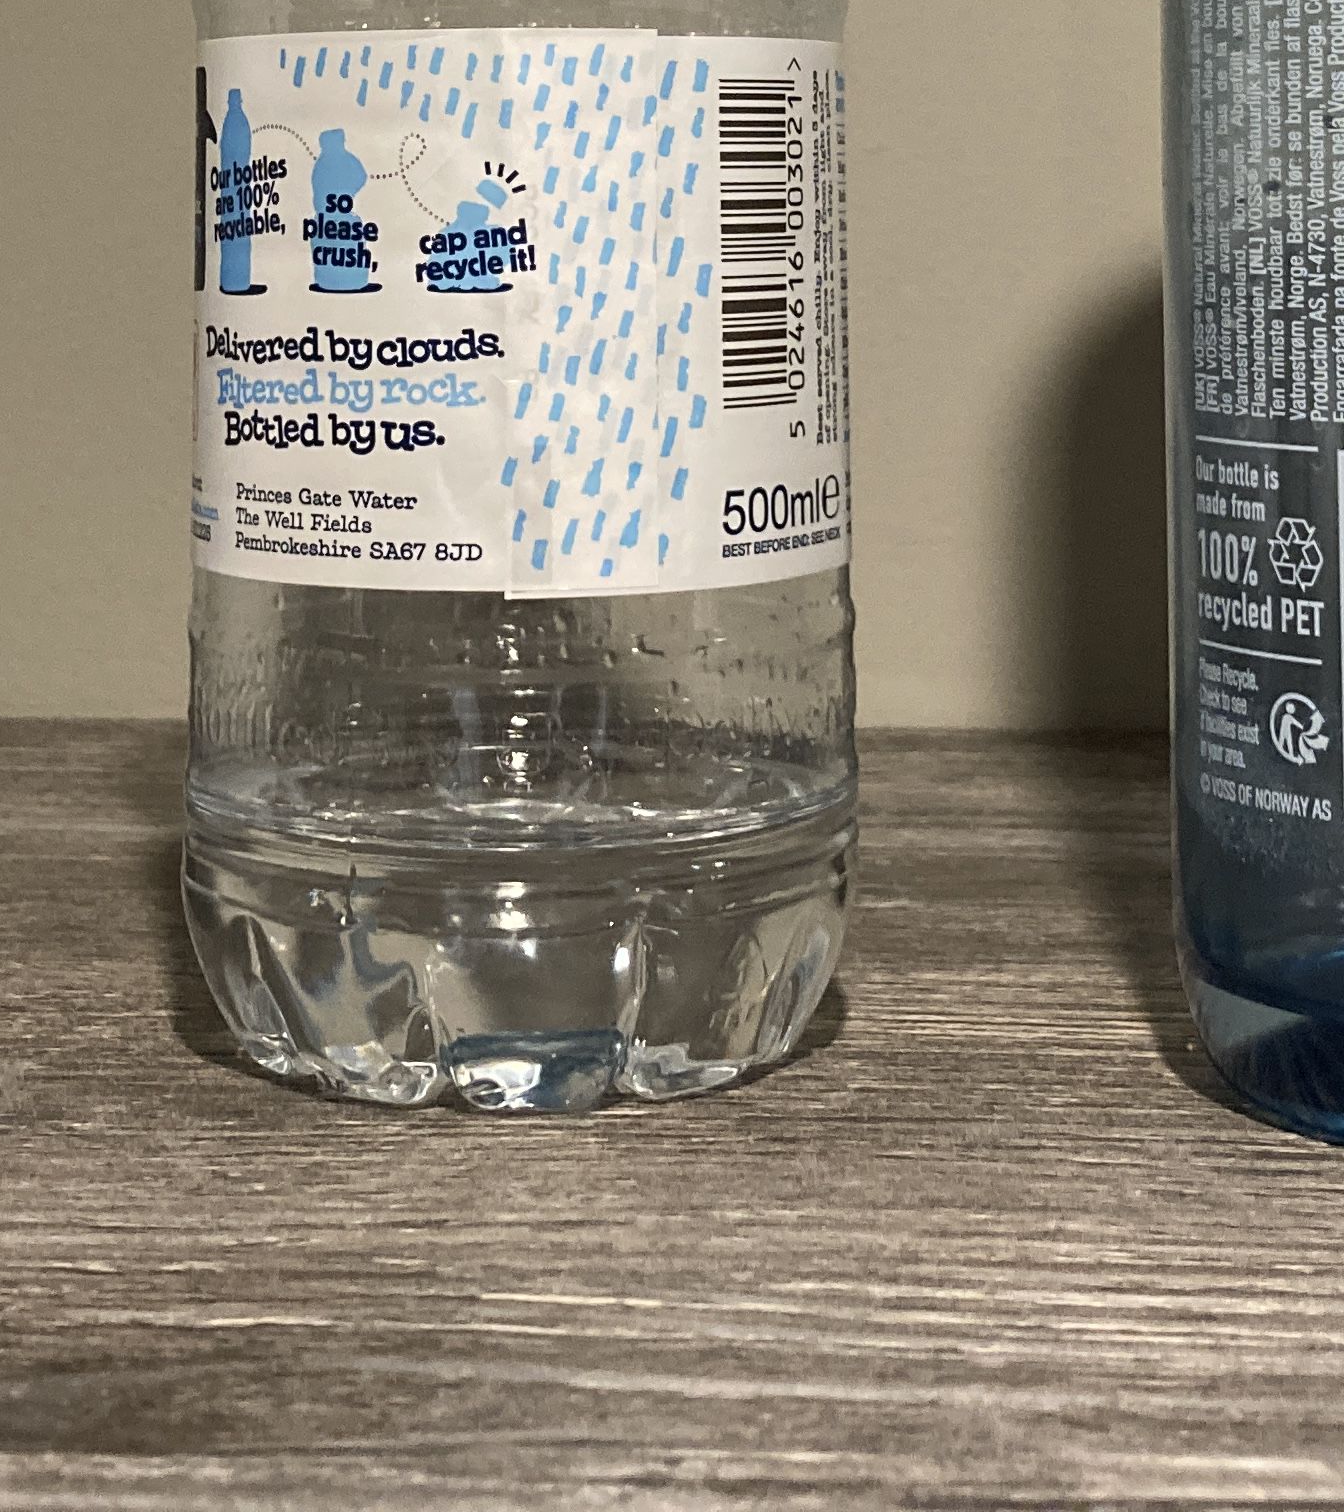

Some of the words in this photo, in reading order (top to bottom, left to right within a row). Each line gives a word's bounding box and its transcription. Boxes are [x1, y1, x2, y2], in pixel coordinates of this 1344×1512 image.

[210, 166, 231, 191] Our
[233, 156, 287, 185] bottles
[787, 96, 804, 229] 003021
[216, 197, 234, 216] are
[237, 181, 279, 213] 100%
[326, 193, 353, 213] so
[214, 208, 286, 242] recyclable,
[303, 213, 378, 241] please
[419, 231, 467, 255] cap
[474, 218, 528, 248] and
[312, 242, 378, 272] crush,
[415, 250, 503, 282] recycle
[509, 245, 536, 272] it!
[787, 251, 804, 391] 024616
[206, 325, 324, 364] Delivered
[325, 330, 372, 370] by
[377, 329, 505, 367] clouds.
[217, 367, 324, 409] Filtered
[328, 371, 373, 412] by
[379, 373, 486, 406] rock.
[224, 409, 324, 449] Bottled
[328, 413, 375, 455] by
[380, 420, 445, 451] us.
[790, 420, 805, 438] 5
[1196, 454, 1214, 481] Our
[1218, 458, 1259, 488] bottle
[1264, 464, 1279, 490] is
[236, 482, 292, 505] Princes
[298, 488, 342, 507] Gate
[349, 490, 418, 510] Water
[1196, 490, 1227, 518] made
[1232, 493, 1265, 521] from
[236, 507, 259, 526] The
[265, 509, 304, 530] Well
[310, 513, 372, 534] Fields
[235, 531, 362, 559] Pembrokeshire
[369, 542, 426, 561] SA67
[434, 543, 483, 561] 8JD
[722, 542, 752, 558] BEST
[753, 536, 791, 554] BEFORE
[1198, 528, 1258, 586] 100%
[1198, 592, 1272, 632] recycled
[1281, 597, 1324, 637] PET
[1211, 775, 1236, 802] VOSS
[1239, 783, 1252, 806] OF
[1255, 787, 1309, 817] NORWAY
[1312, 798, 1332, 821] AS
